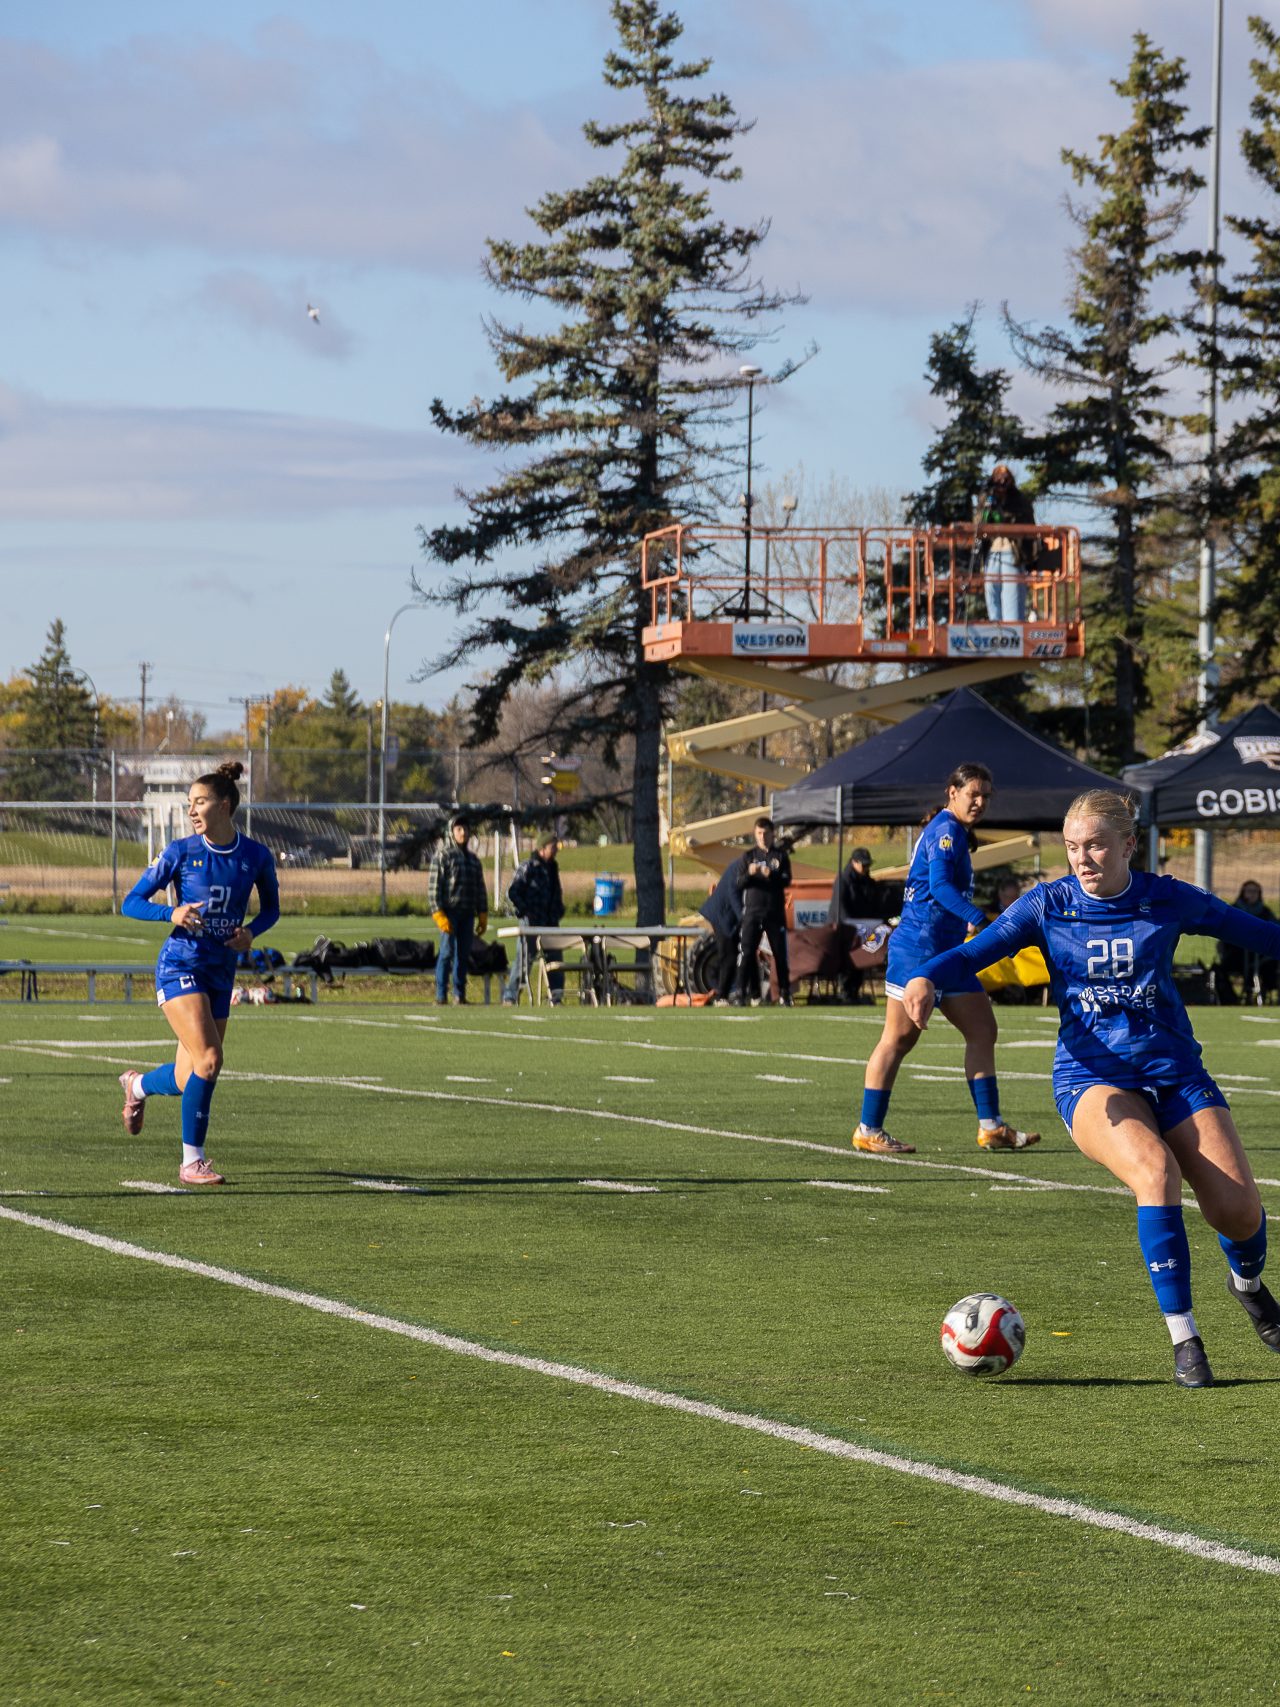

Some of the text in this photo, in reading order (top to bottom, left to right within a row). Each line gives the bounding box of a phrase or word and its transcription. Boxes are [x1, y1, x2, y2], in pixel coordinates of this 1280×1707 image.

[735, 633, 807, 647] WESTCON
[207, 885, 232, 914] 21
[1086, 937, 1134, 979] 28
[1094, 984, 1157, 999] CEDAR
